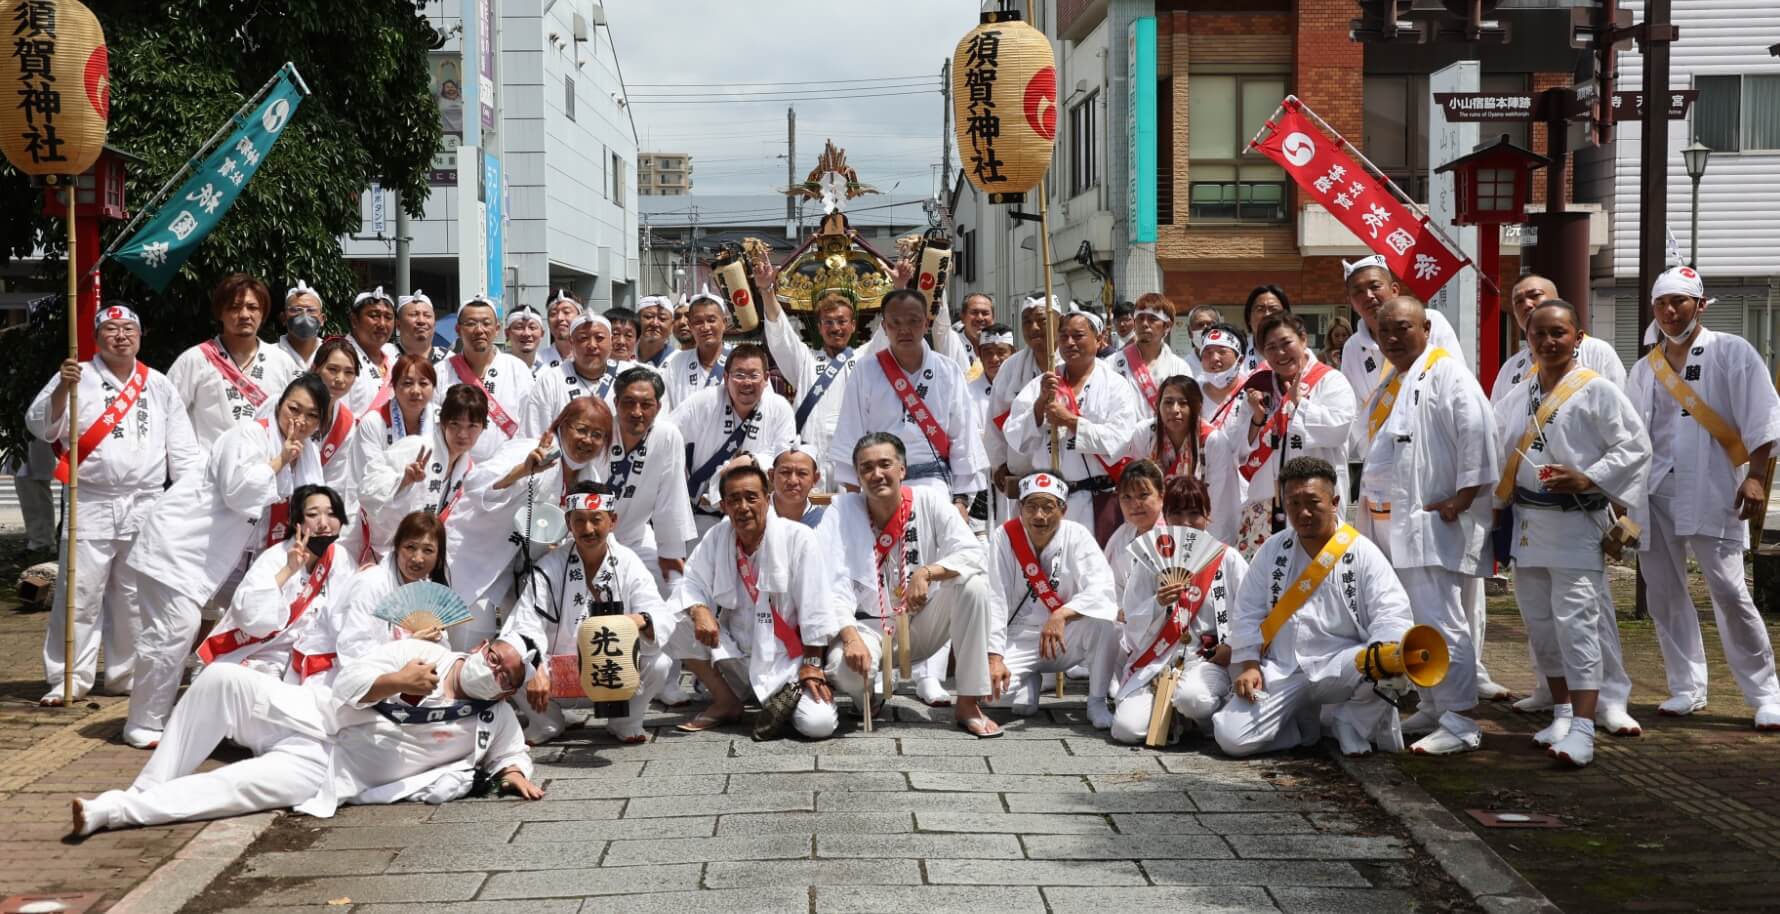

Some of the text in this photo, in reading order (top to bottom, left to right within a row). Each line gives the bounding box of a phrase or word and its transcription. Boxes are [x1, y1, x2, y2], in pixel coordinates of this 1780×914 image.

[12, 0, 67, 164] 須賀神社
[965, 31, 1007, 185] 須賀神社
[590, 626, 624, 690] 先達
